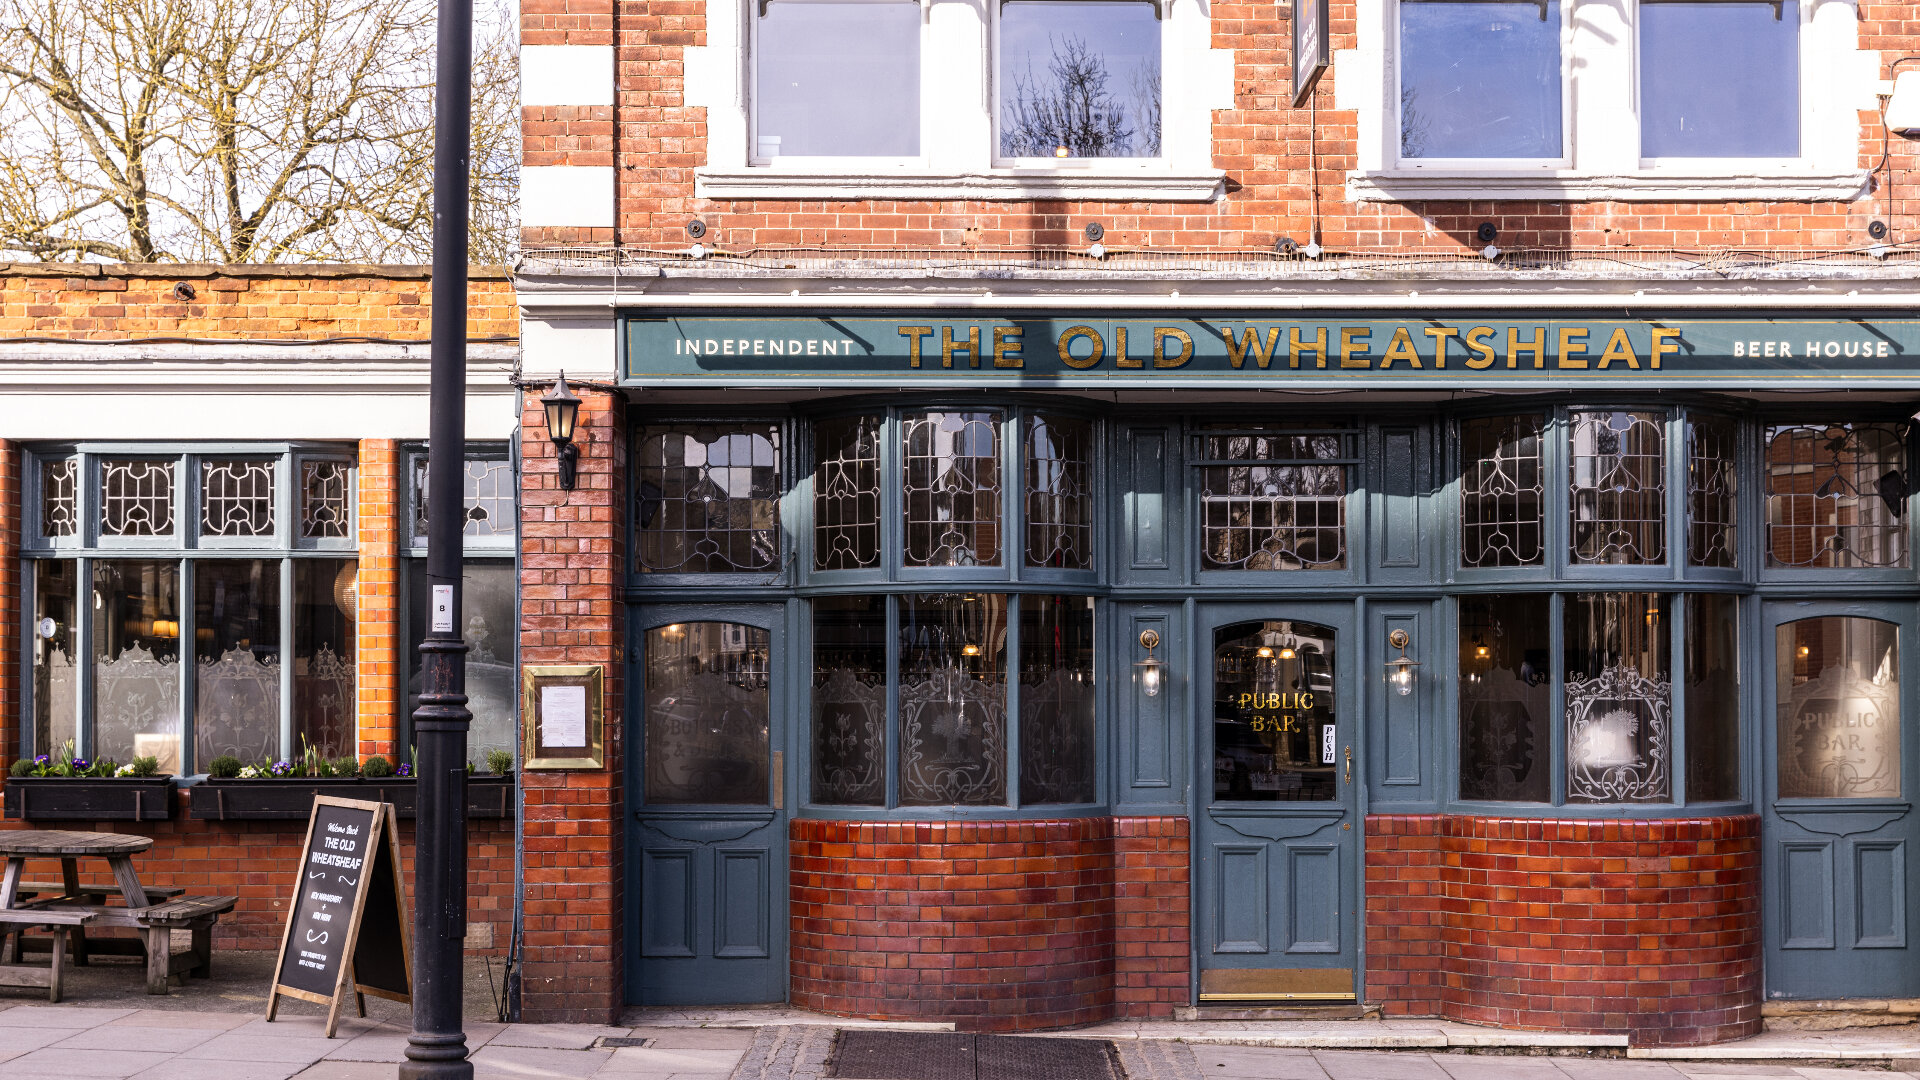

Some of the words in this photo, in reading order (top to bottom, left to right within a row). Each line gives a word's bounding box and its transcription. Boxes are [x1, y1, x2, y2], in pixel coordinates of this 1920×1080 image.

[675, 338, 854, 356] INDEPENDENT
[897, 325, 1025, 370] THE
[1057, 325, 1196, 370] OLD
[1220, 326, 1684, 371] WHEATSHEAF
[1733, 340, 1792, 359] BEER
[1806, 341, 1890, 359] HOUSE
[1237, 692, 1314, 710] PUBLIC
[1249, 715, 1301, 734] BAR
[1802, 712, 1875, 730] PUBLIC
[1324, 726, 1333, 761] PUSH
[1817, 734, 1864, 751] BAR
[324, 837, 339, 849] THE
[340, 839, 355, 851] OLD
[311, 852, 362, 870] WHEATSHEAF
